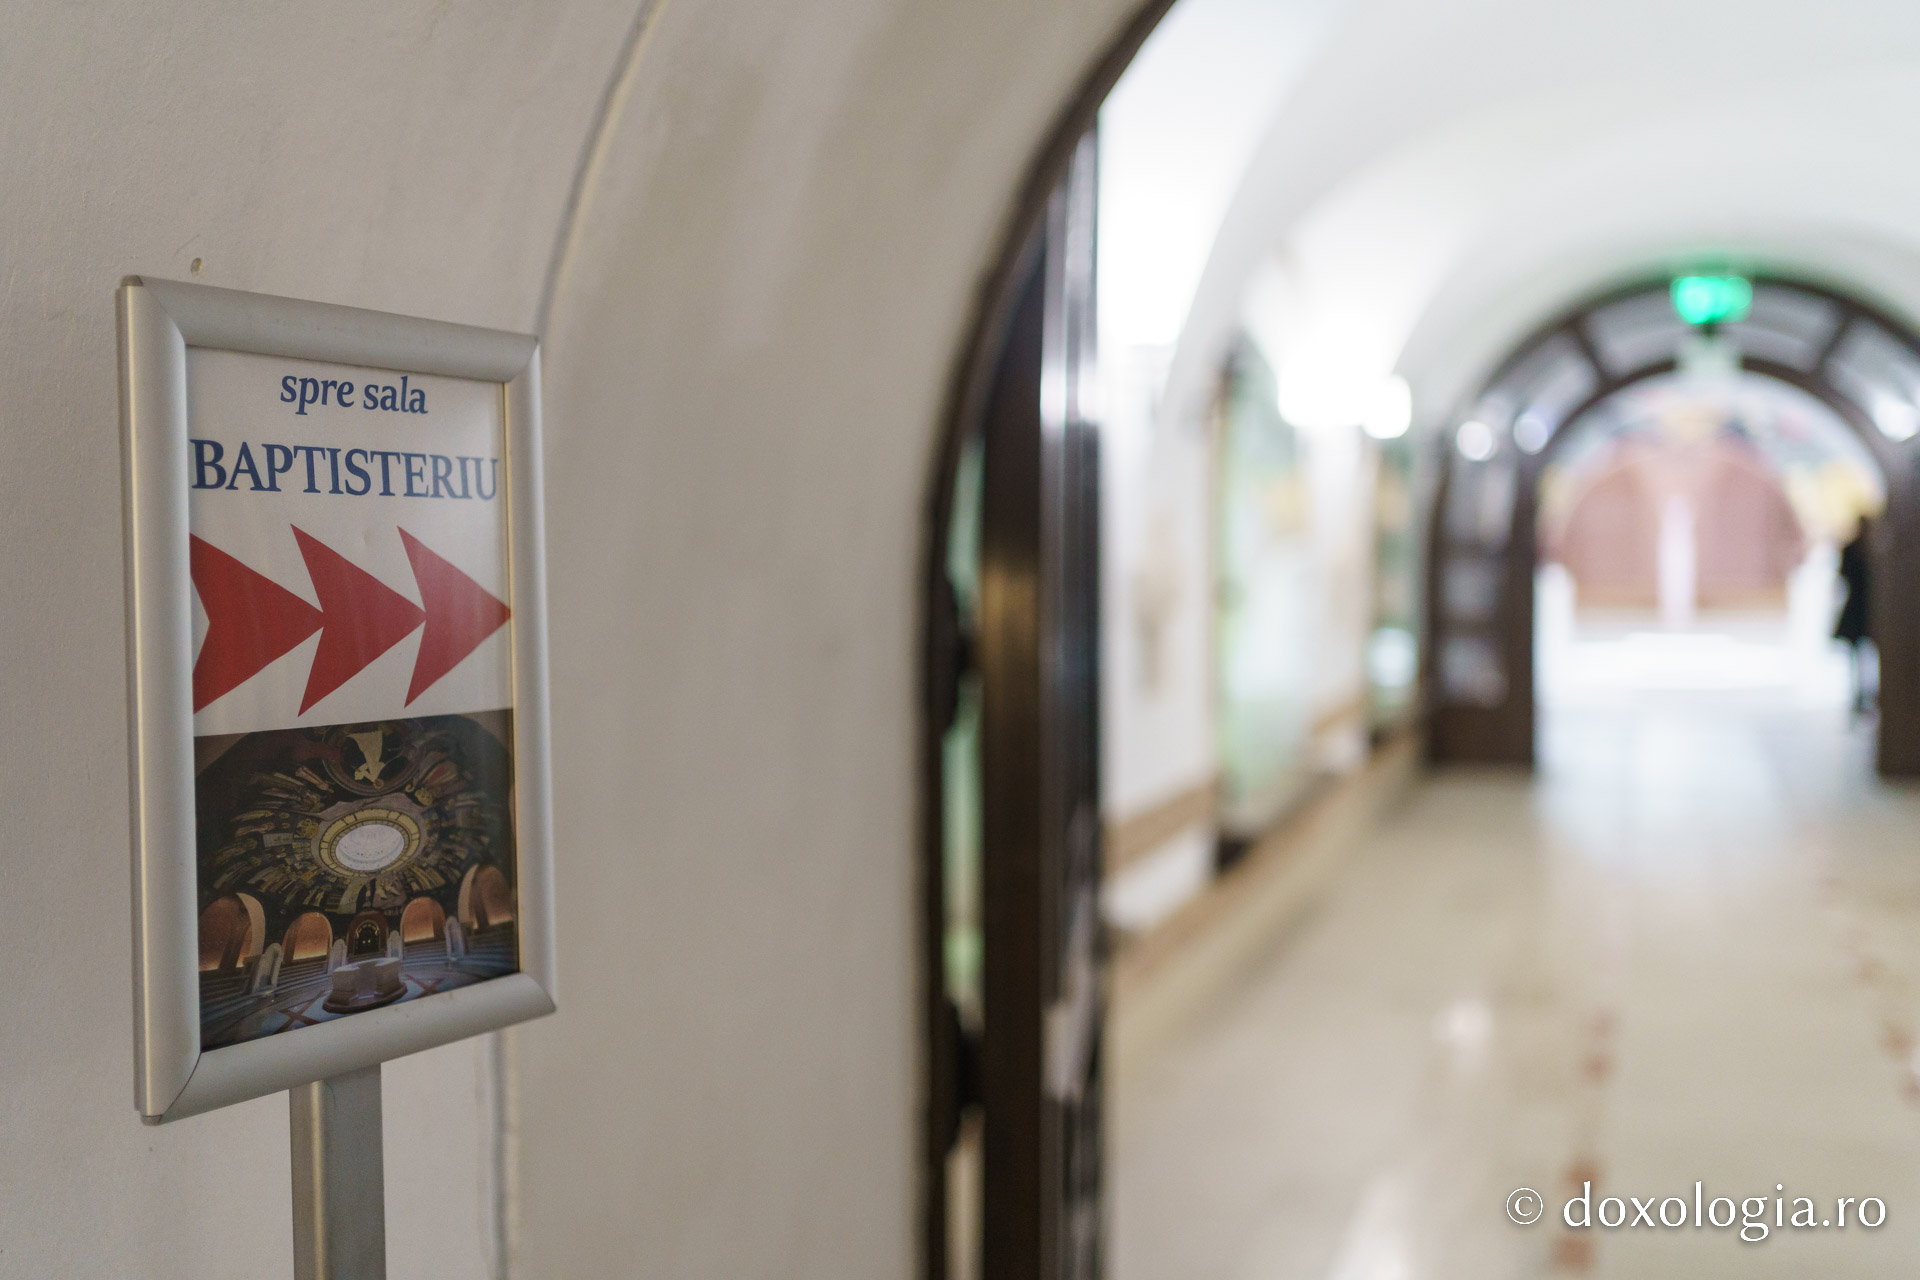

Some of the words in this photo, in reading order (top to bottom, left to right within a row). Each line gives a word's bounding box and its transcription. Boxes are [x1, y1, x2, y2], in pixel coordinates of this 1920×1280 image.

[280, 375, 355, 415] spre
[363, 376, 428, 414] sala
[189, 439, 498, 501] BAPTISTERIU
